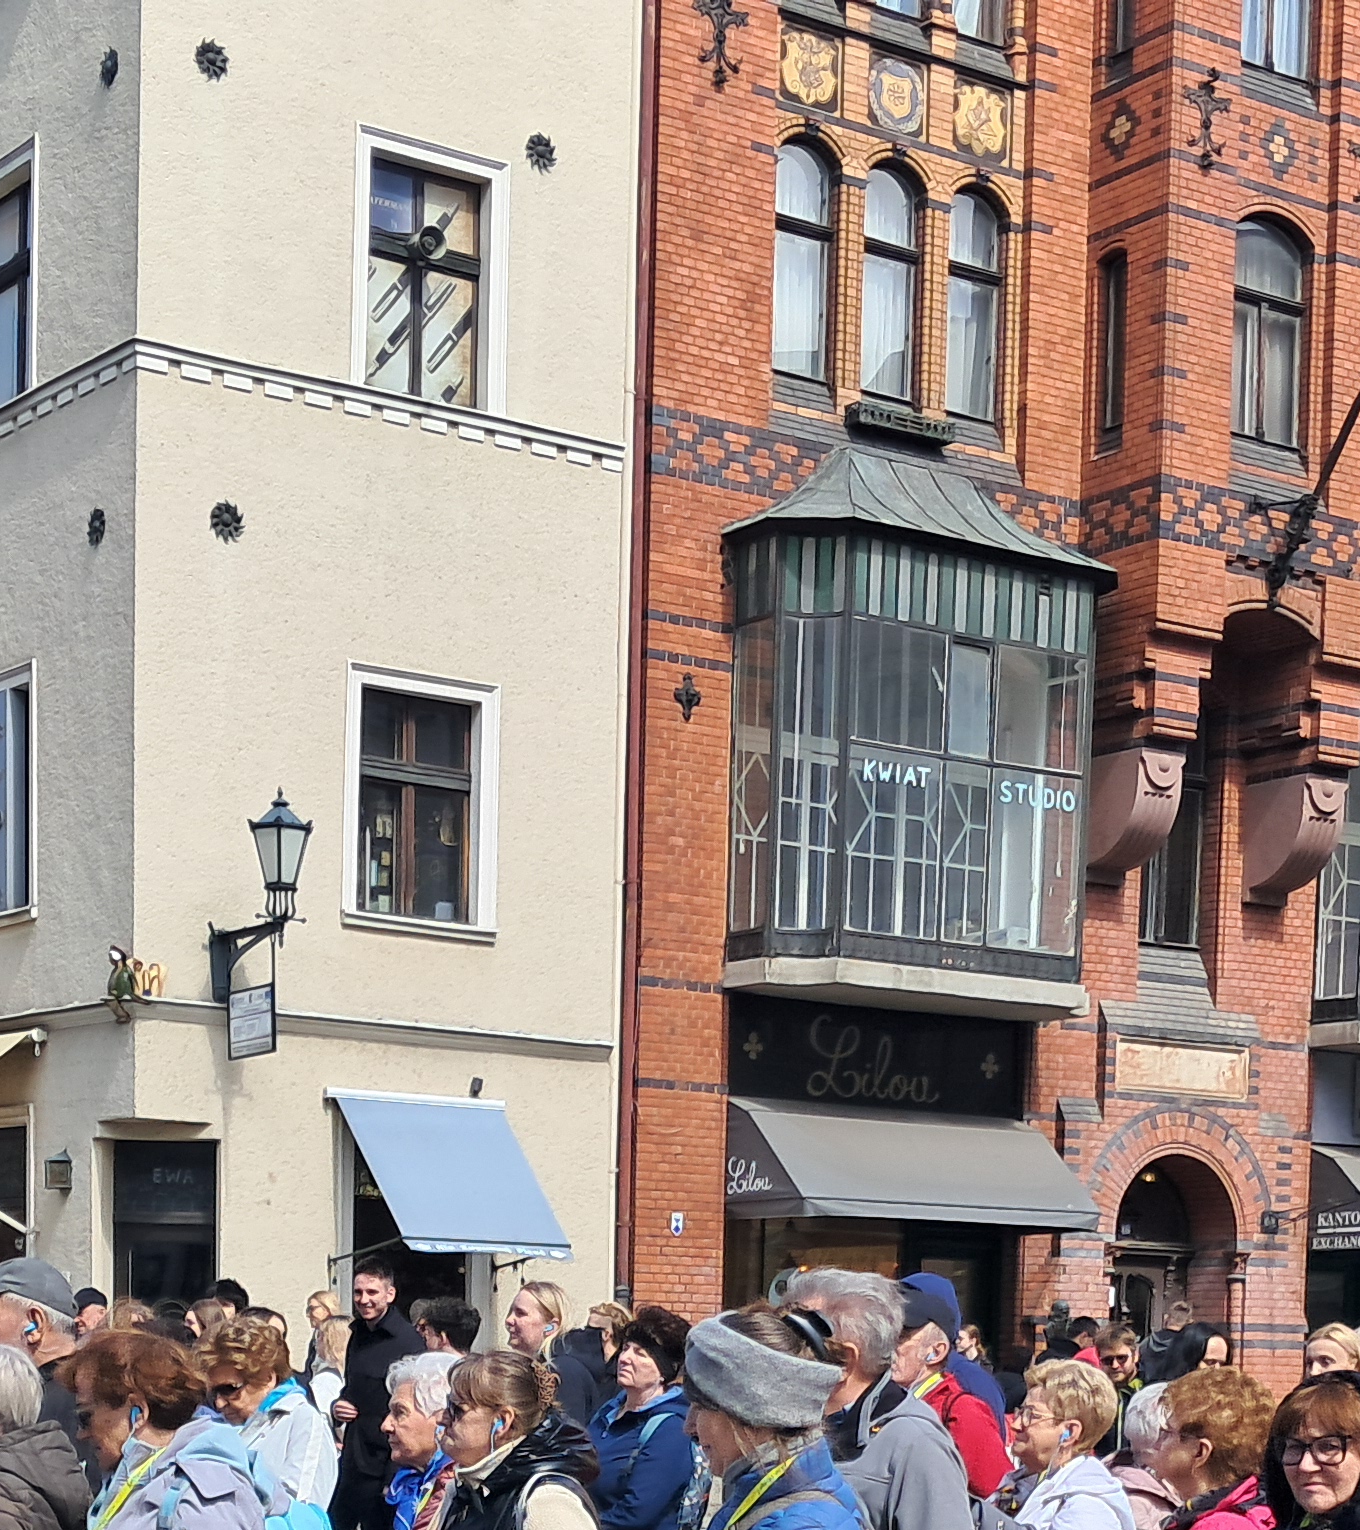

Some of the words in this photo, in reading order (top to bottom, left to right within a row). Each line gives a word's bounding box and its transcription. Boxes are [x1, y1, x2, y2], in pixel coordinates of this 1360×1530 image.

[862, 758, 932, 788] KWIAT
[999, 780, 1076, 812] STUDIO
[806, 1014, 939, 1103] Lilou
[727, 1156, 773, 1195] Lilou
